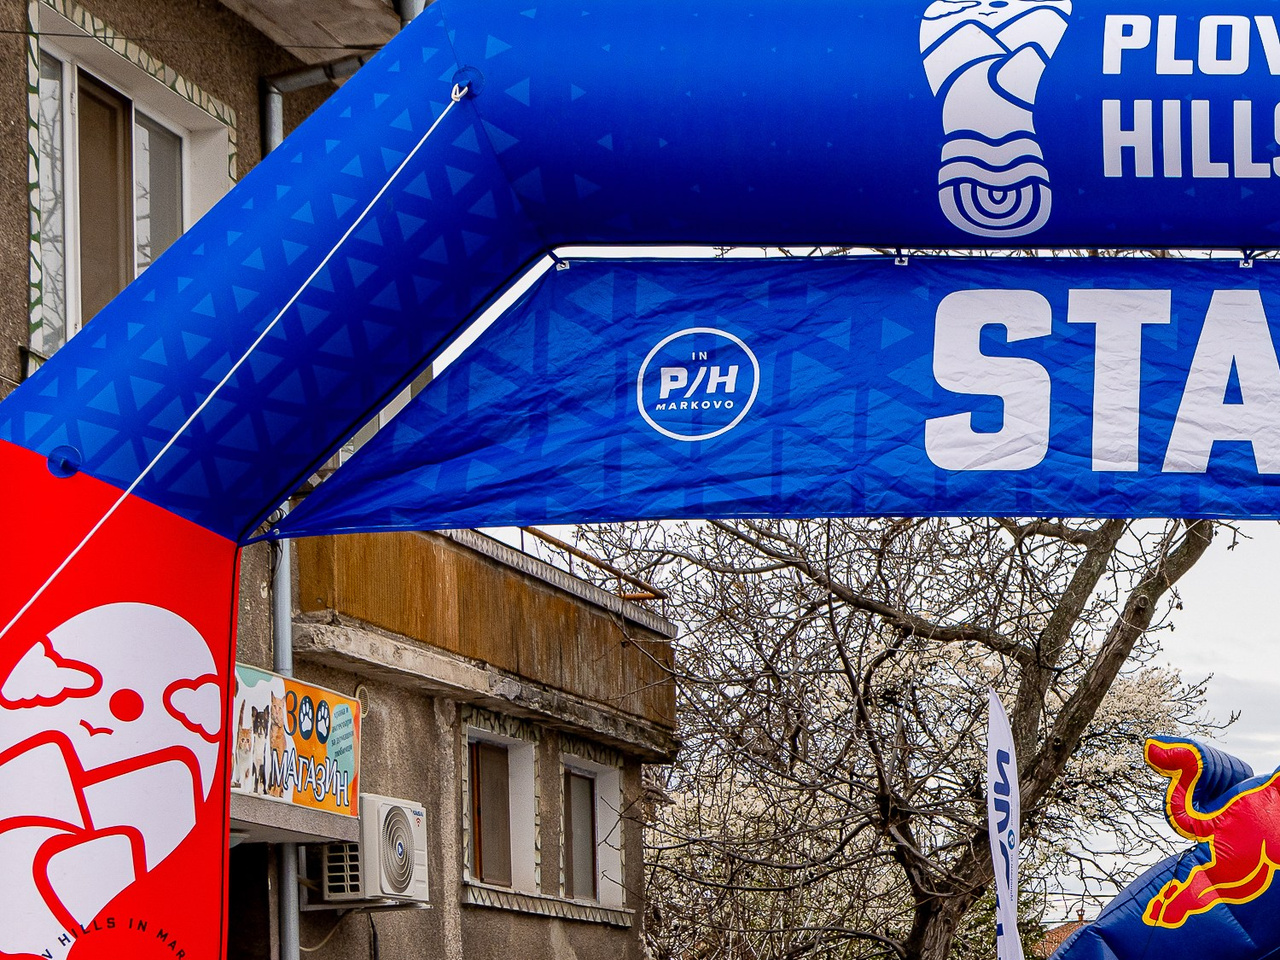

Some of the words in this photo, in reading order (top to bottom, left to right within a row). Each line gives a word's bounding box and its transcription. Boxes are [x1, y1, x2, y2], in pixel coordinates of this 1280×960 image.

[691, 351, 708, 361] IN
[659, 365, 739, 399] P/H
[655, 400, 734, 411] MARKOVO
[271, 748, 349, 806] МАГАЗИН
[58, 917, 115, 946] HILLS
[129, 918, 148, 932] IN
